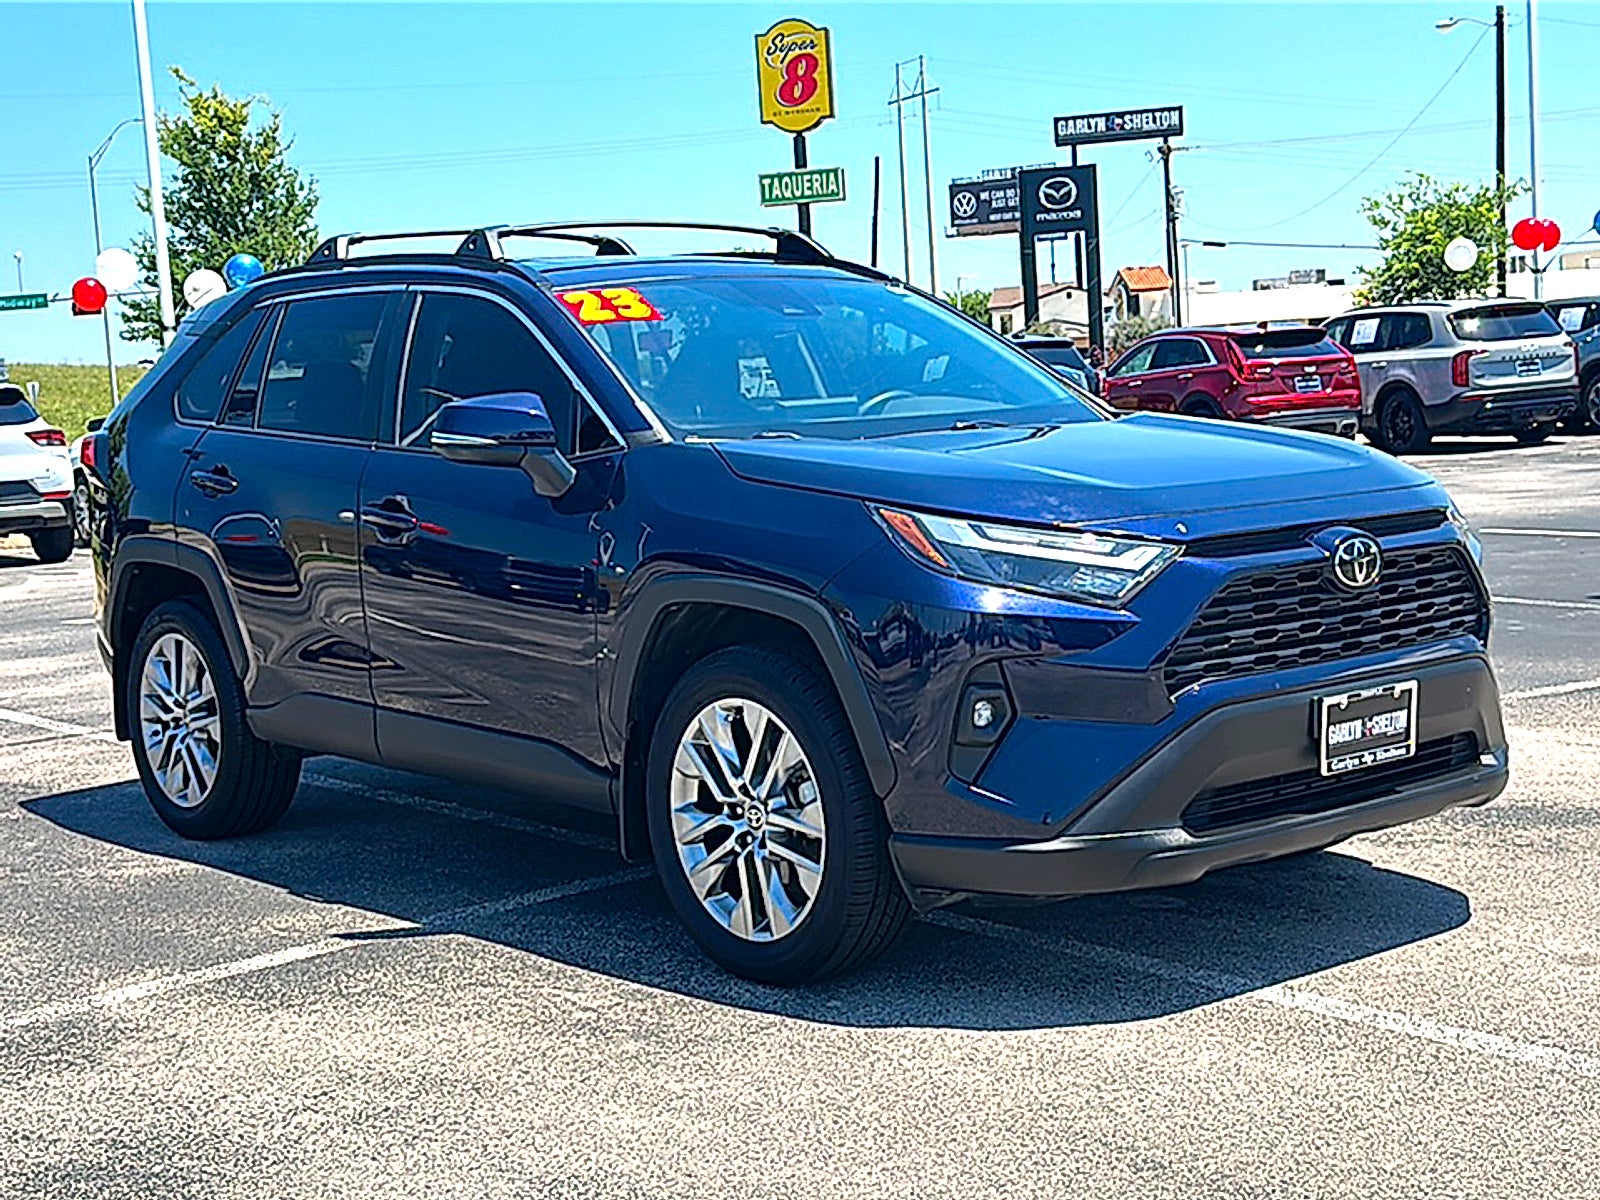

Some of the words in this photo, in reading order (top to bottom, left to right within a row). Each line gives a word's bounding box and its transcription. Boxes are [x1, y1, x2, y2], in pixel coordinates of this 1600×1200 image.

[766, 32, 818, 64] Super
[776, 52, 819, 107] 8
[1057, 116, 1107, 136] GARLYN
[1123, 110, 1180, 130] SHELTON
[762, 171, 838, 199] TAQUERIA
[563, 288, 651, 321] 23
